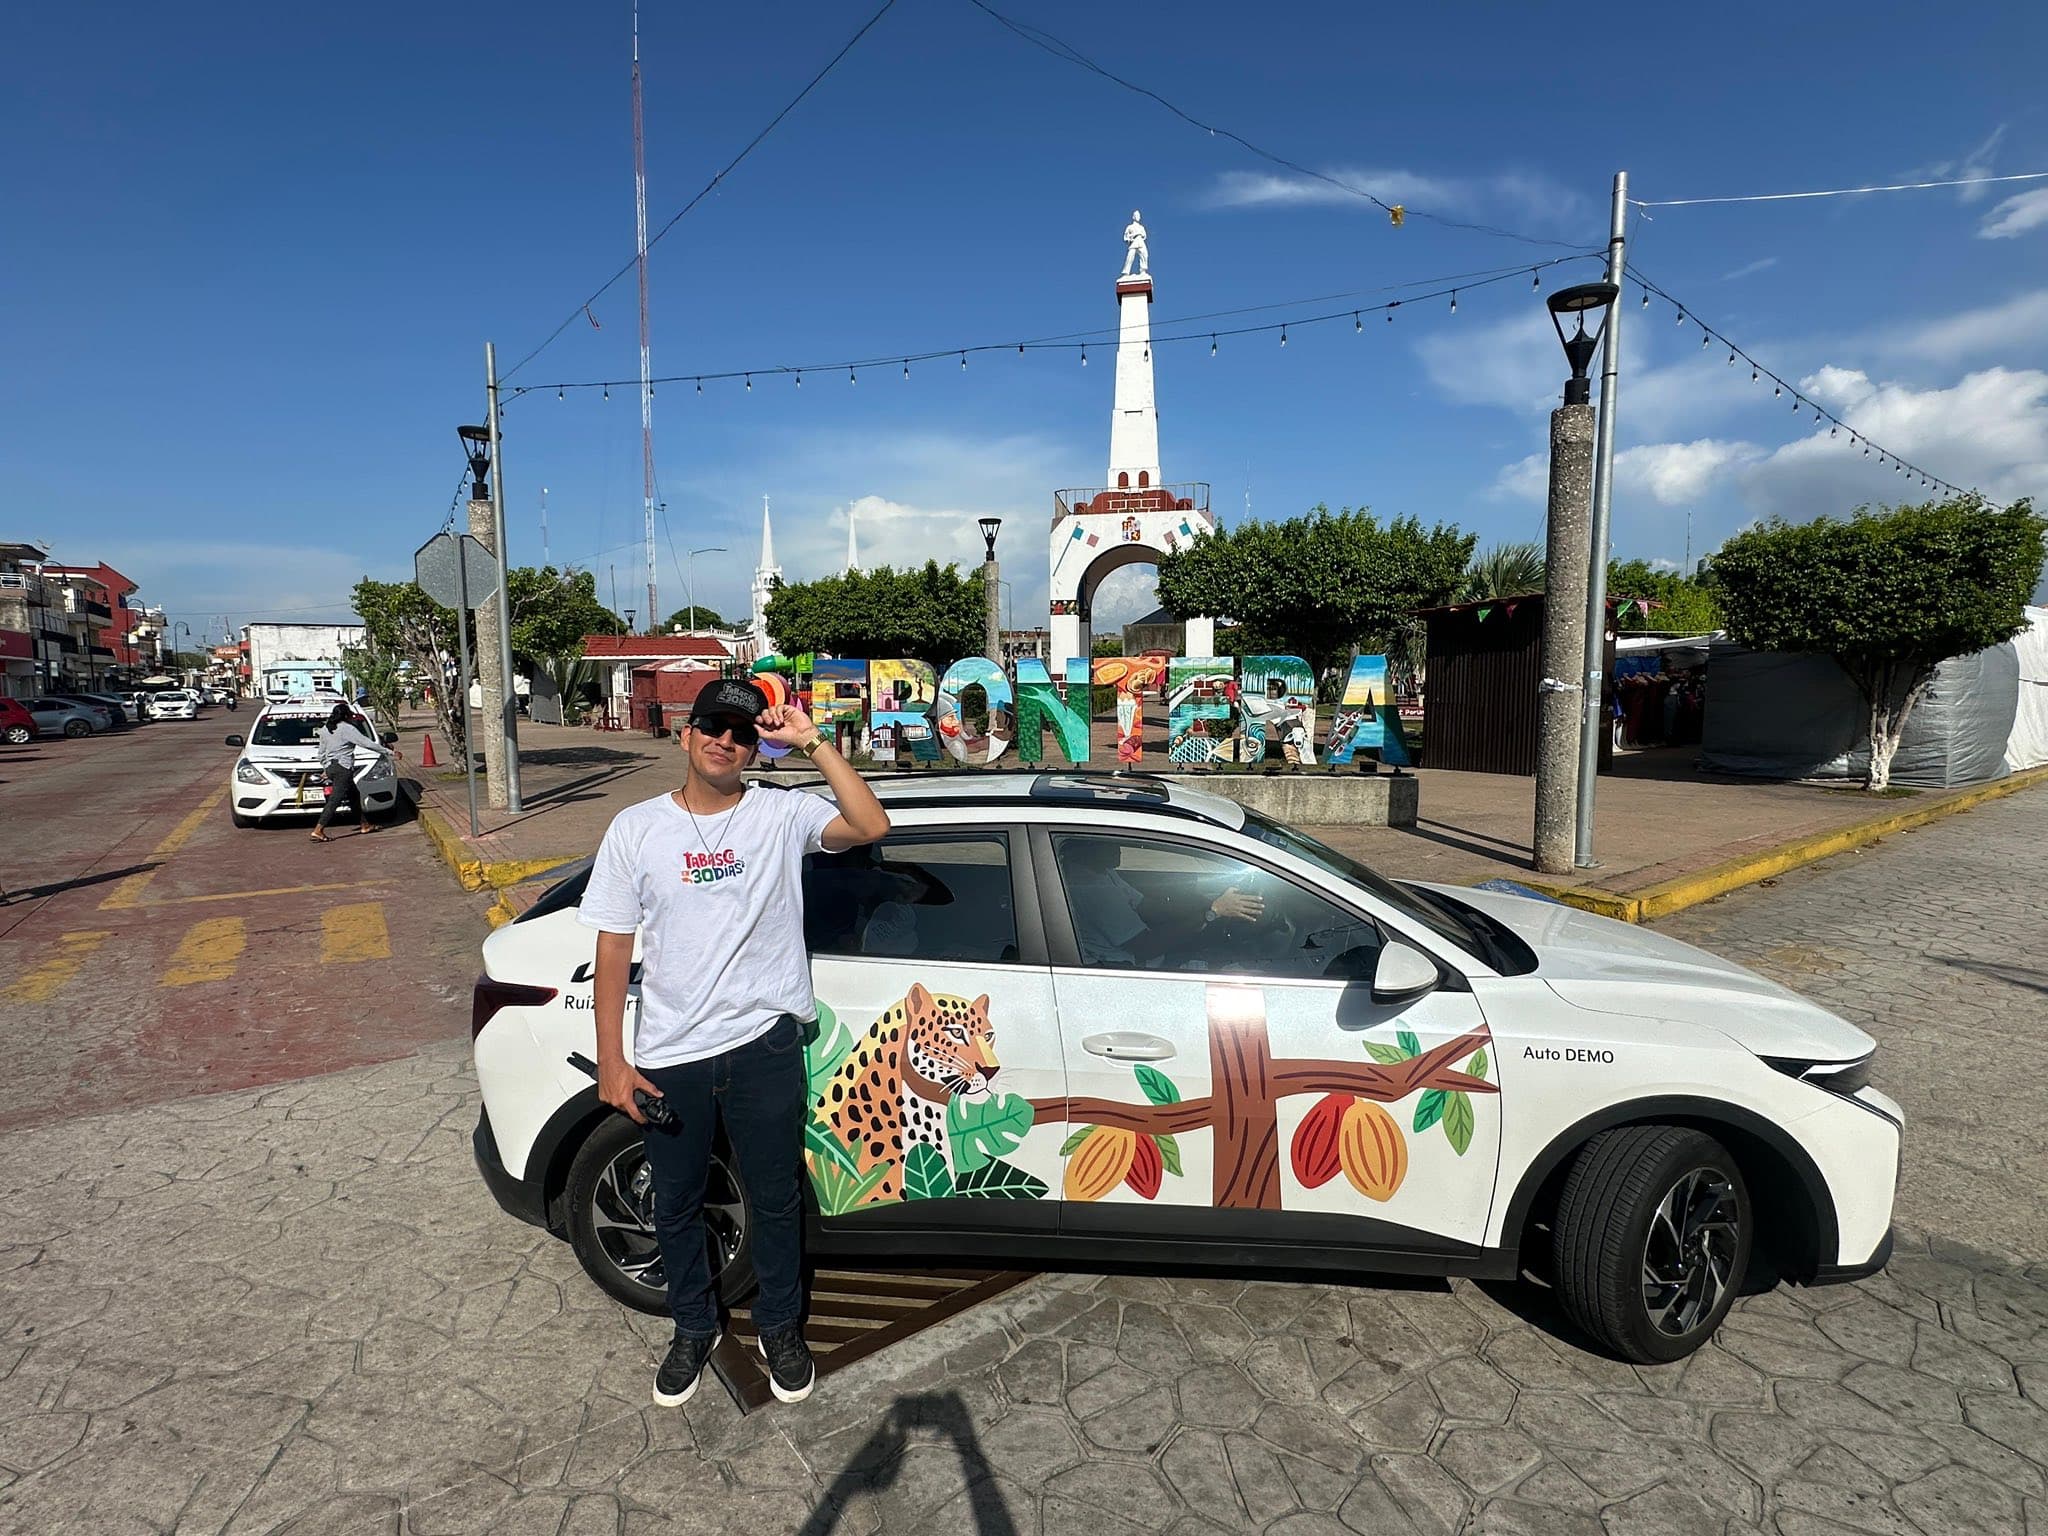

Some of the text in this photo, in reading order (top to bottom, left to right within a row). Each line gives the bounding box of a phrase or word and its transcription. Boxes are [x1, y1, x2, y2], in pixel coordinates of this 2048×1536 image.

[812, 654, 1411, 767] FRONTERA
[683, 849, 735, 869] TABASCO
[691, 868, 714, 884] 30
[1523, 1046, 1614, 1064] Auto DEMO
